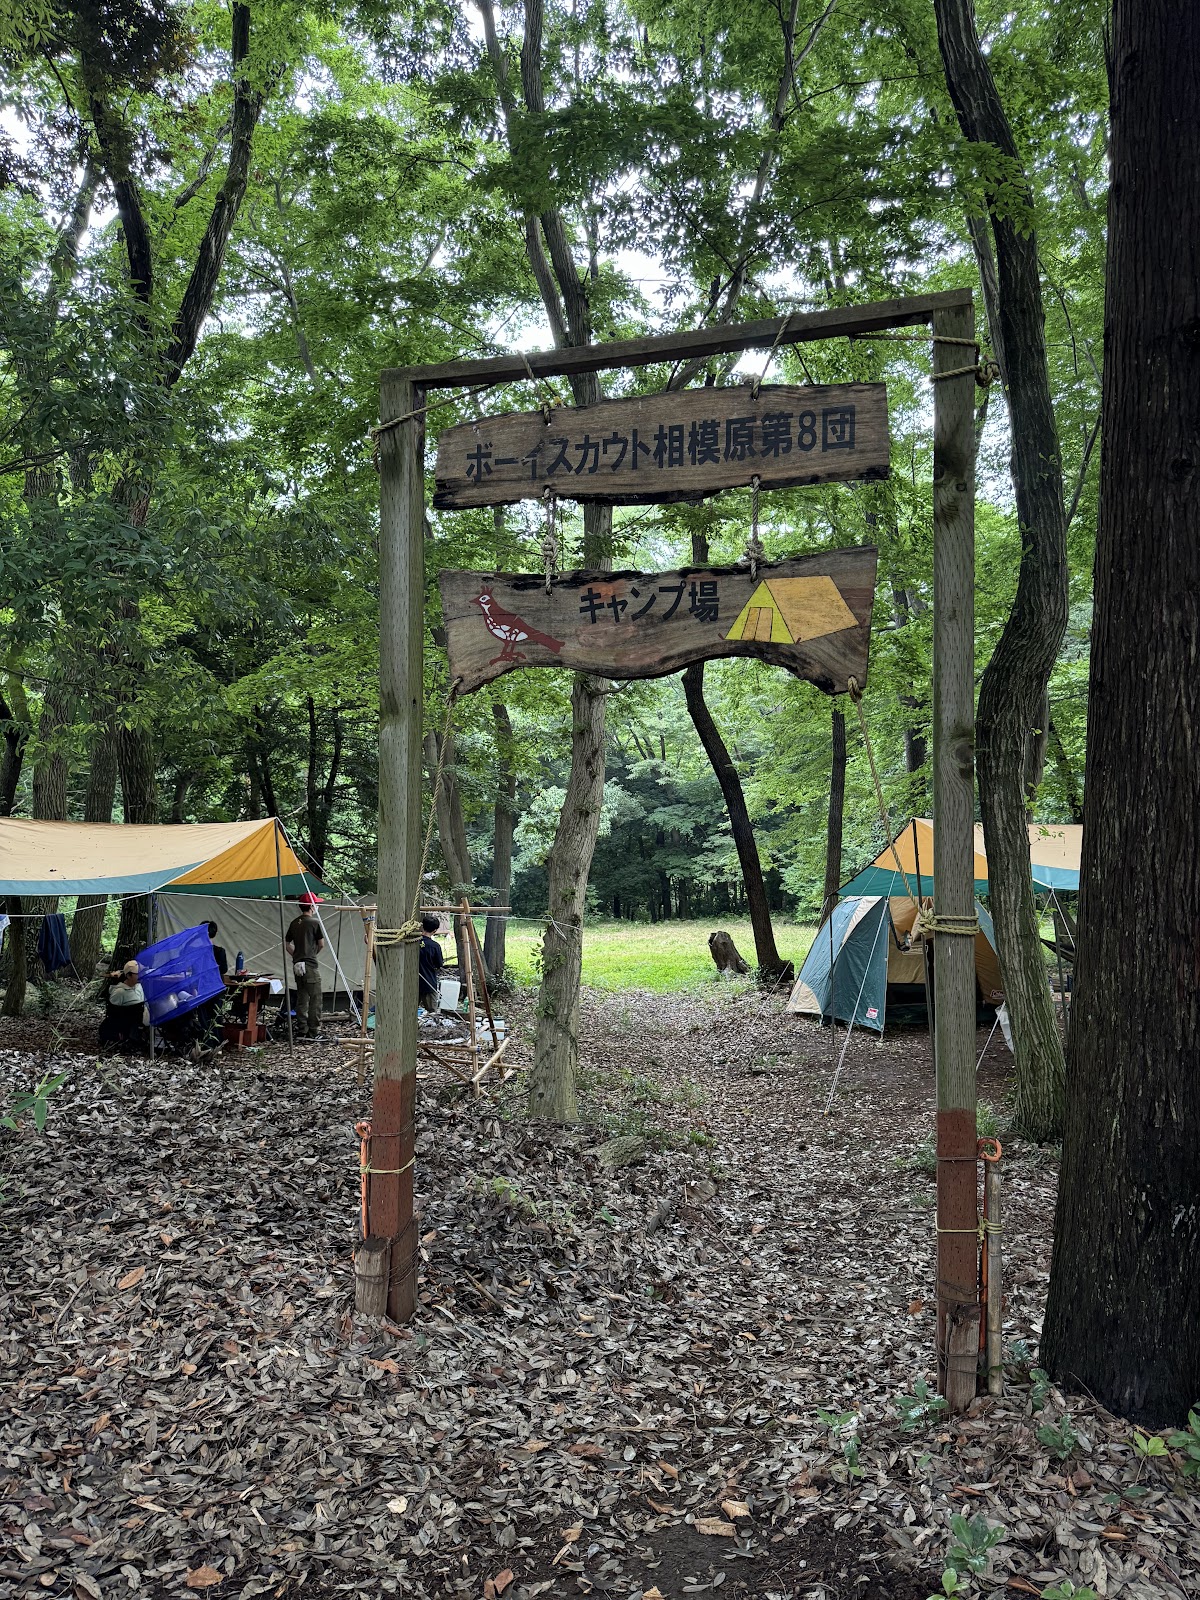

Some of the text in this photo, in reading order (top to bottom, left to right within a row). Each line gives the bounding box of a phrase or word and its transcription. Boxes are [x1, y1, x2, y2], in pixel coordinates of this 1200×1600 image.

[465, 404, 856, 483] ボーイスカウト相模原第8団
[579, 580, 720, 624] キャンプ場
